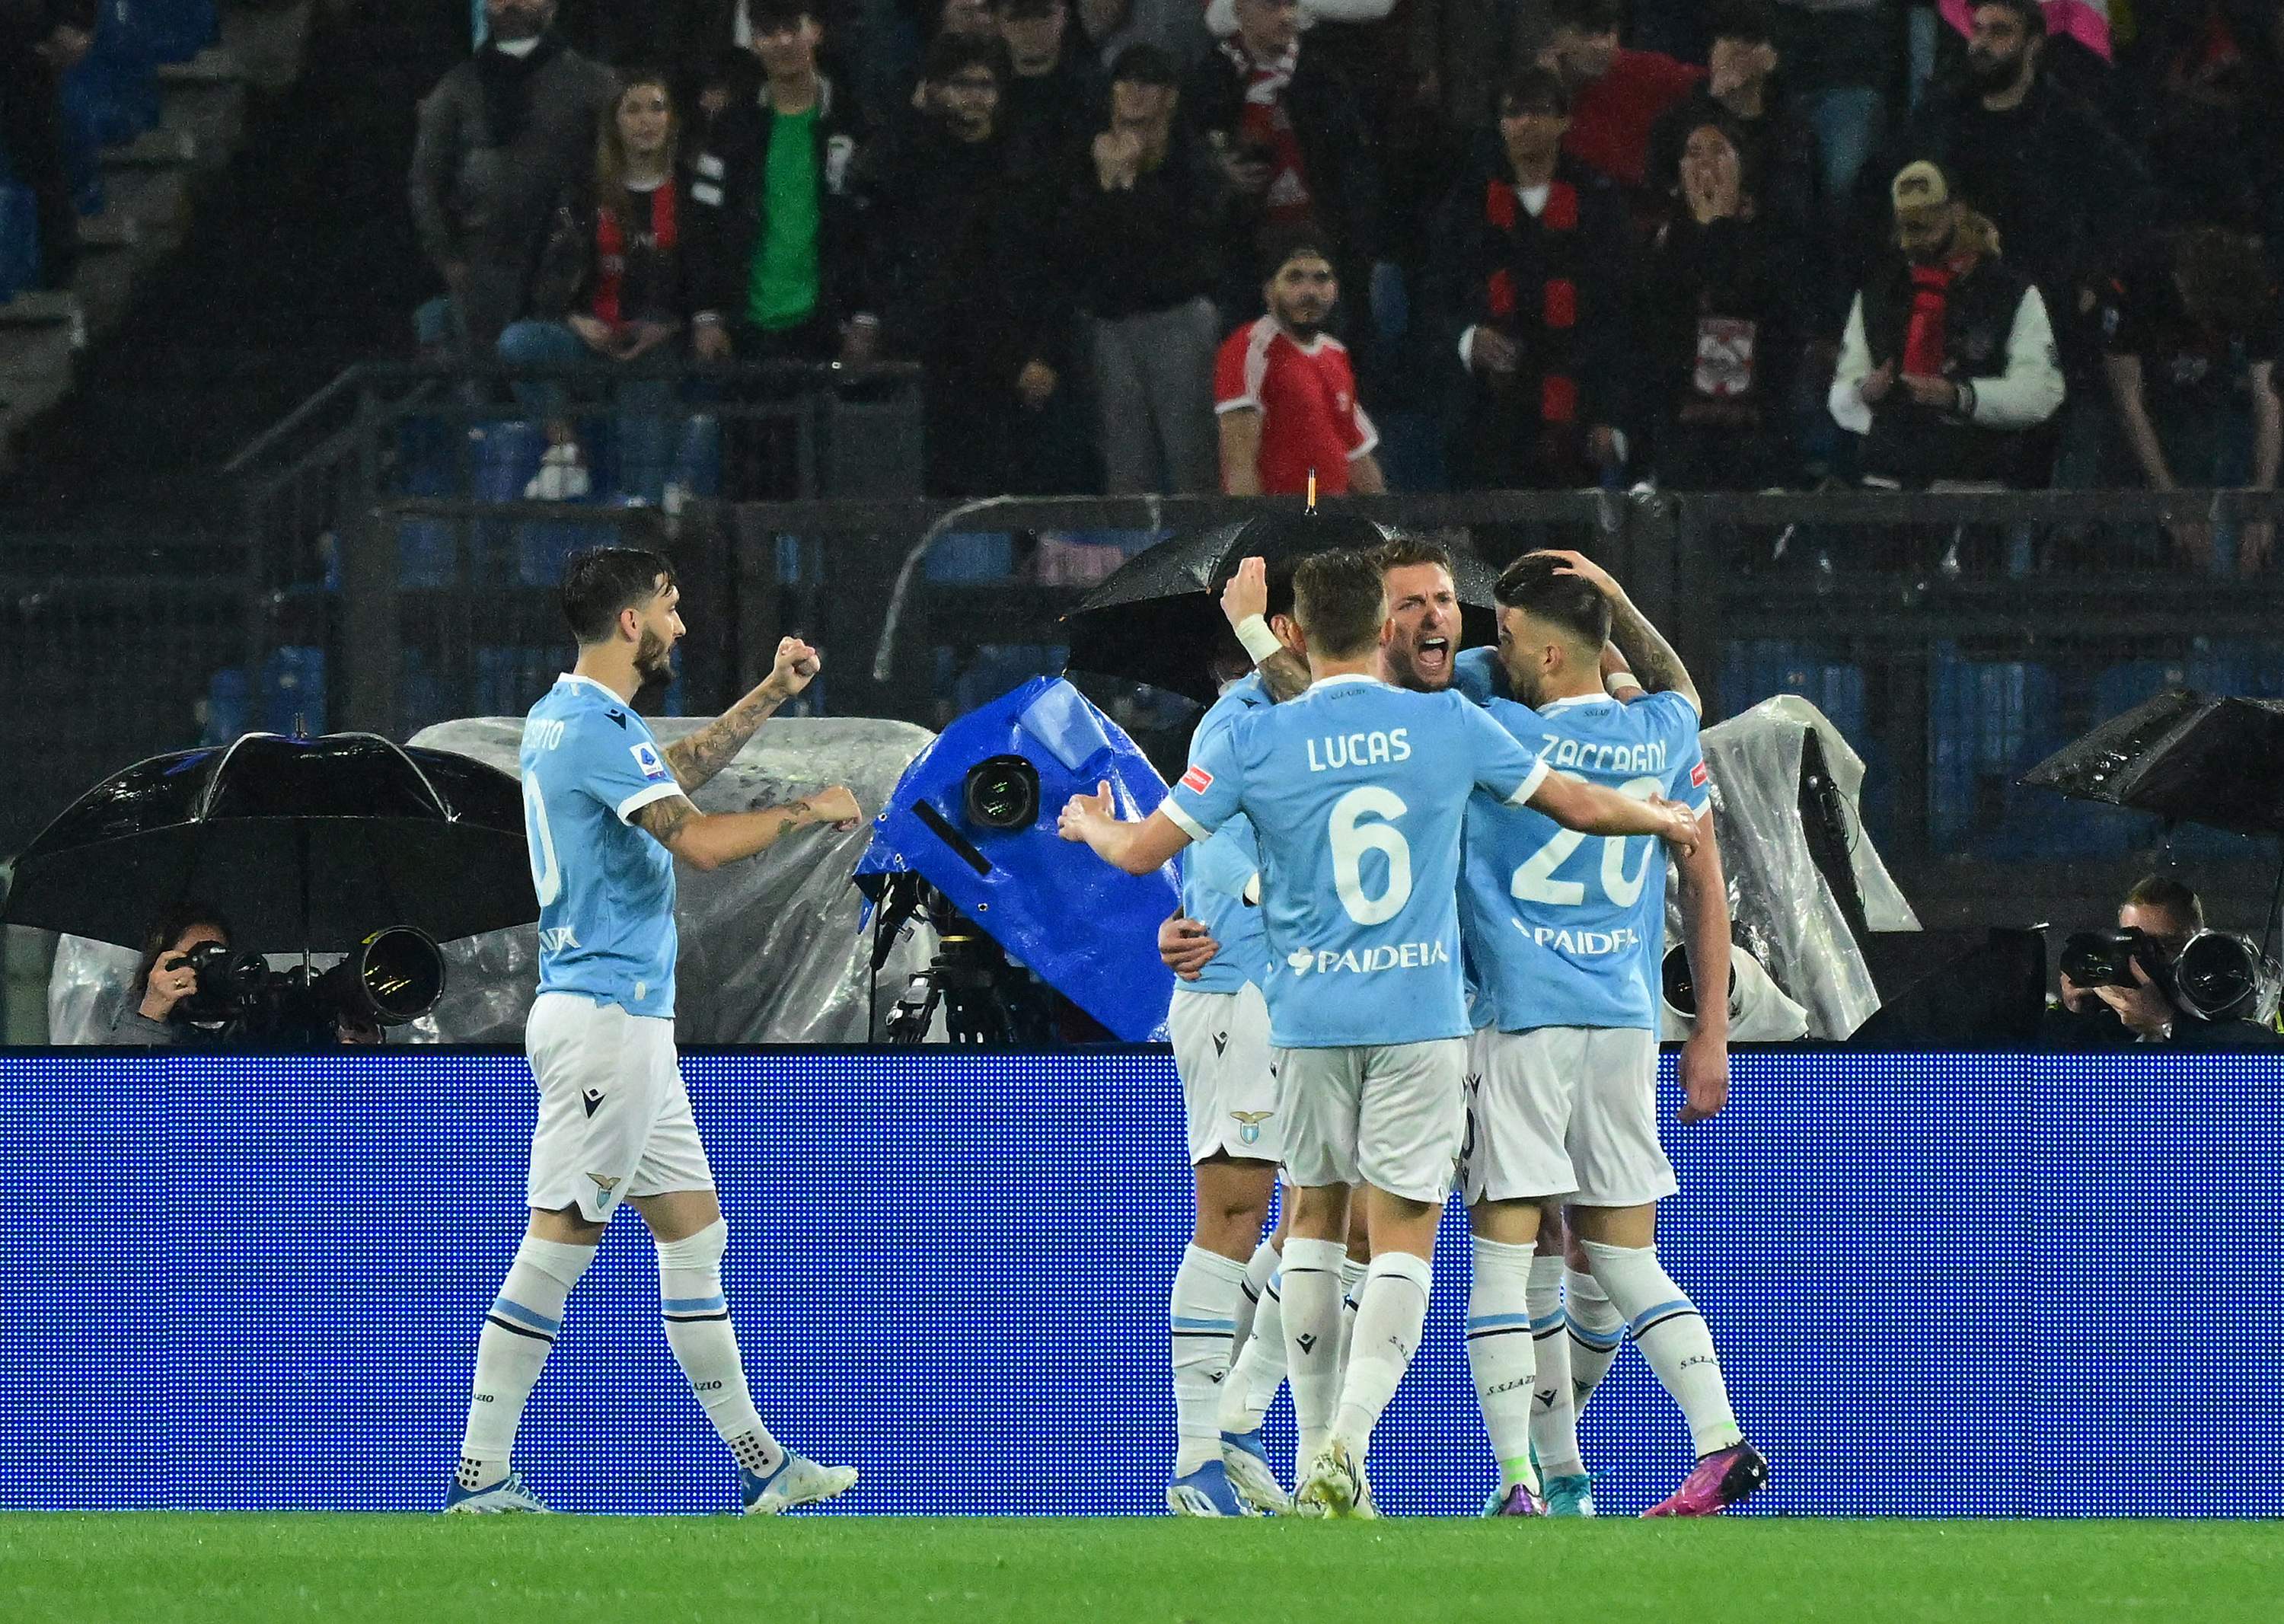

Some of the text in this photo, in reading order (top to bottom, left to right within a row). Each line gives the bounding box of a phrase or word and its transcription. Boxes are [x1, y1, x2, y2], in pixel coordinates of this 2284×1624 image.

[1307, 728, 1412, 772] LUCAS
[1329, 785, 1412, 926] 6
[1510, 771, 1664, 908] 20
[1318, 940, 1450, 974] PAIDEIA
